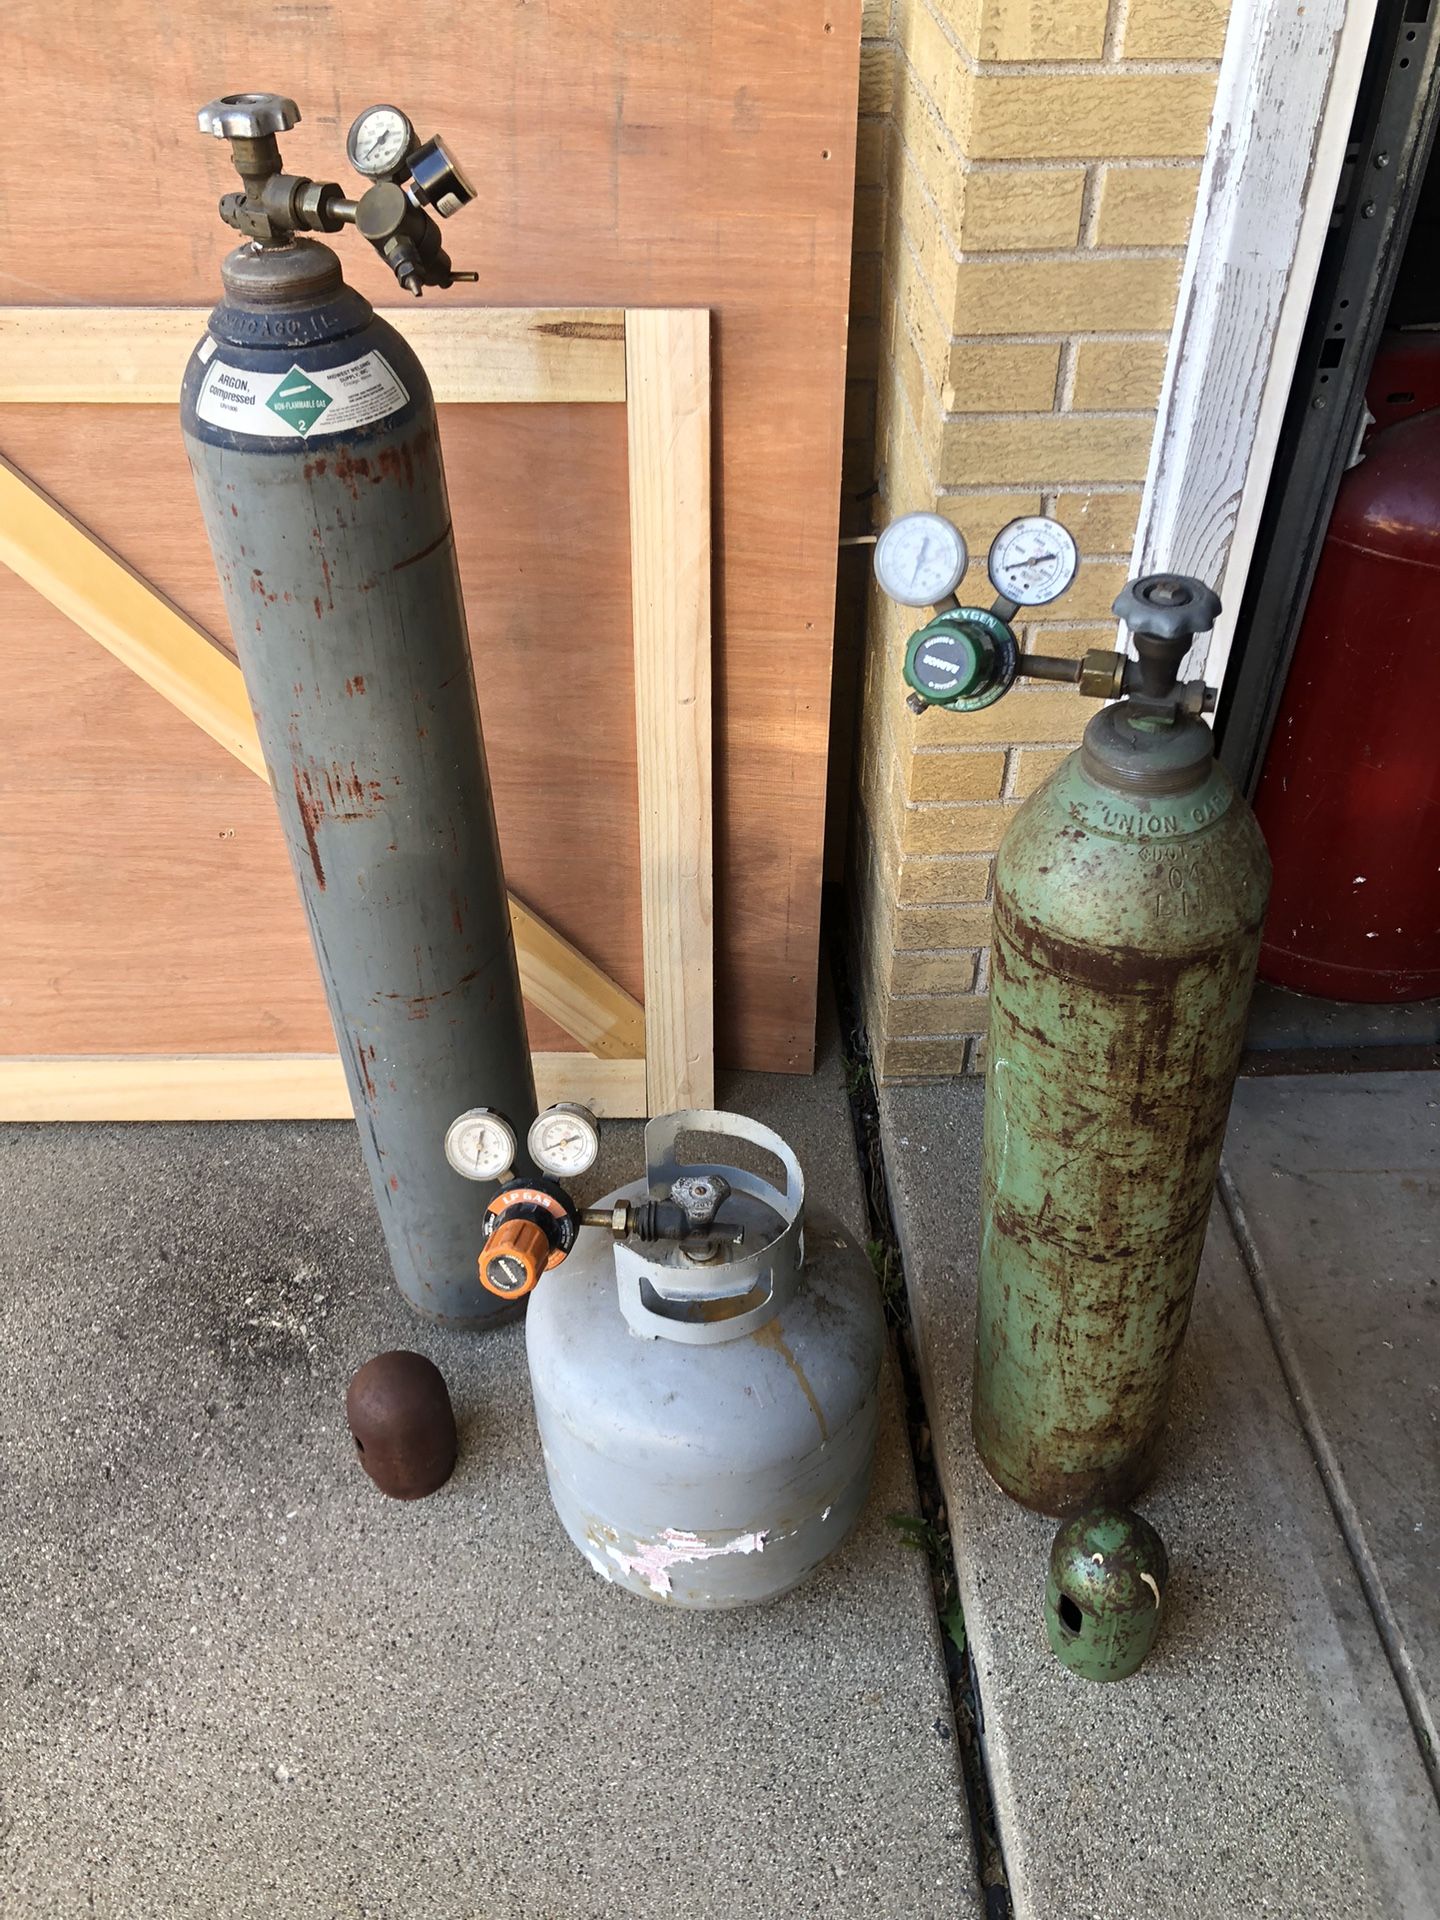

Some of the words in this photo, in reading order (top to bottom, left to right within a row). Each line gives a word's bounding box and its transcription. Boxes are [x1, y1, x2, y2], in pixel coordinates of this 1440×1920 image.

[218, 373, 250, 392] ARGON,
[209, 385, 256, 406] compressed
[273, 400, 315, 412] NON-FLAMMABLE
[315, 399, 327, 409] GAS
[298, 420, 306, 431] 2
[502, 1192, 519, 1205] LP
[522, 1192, 552, 1207] GAS
